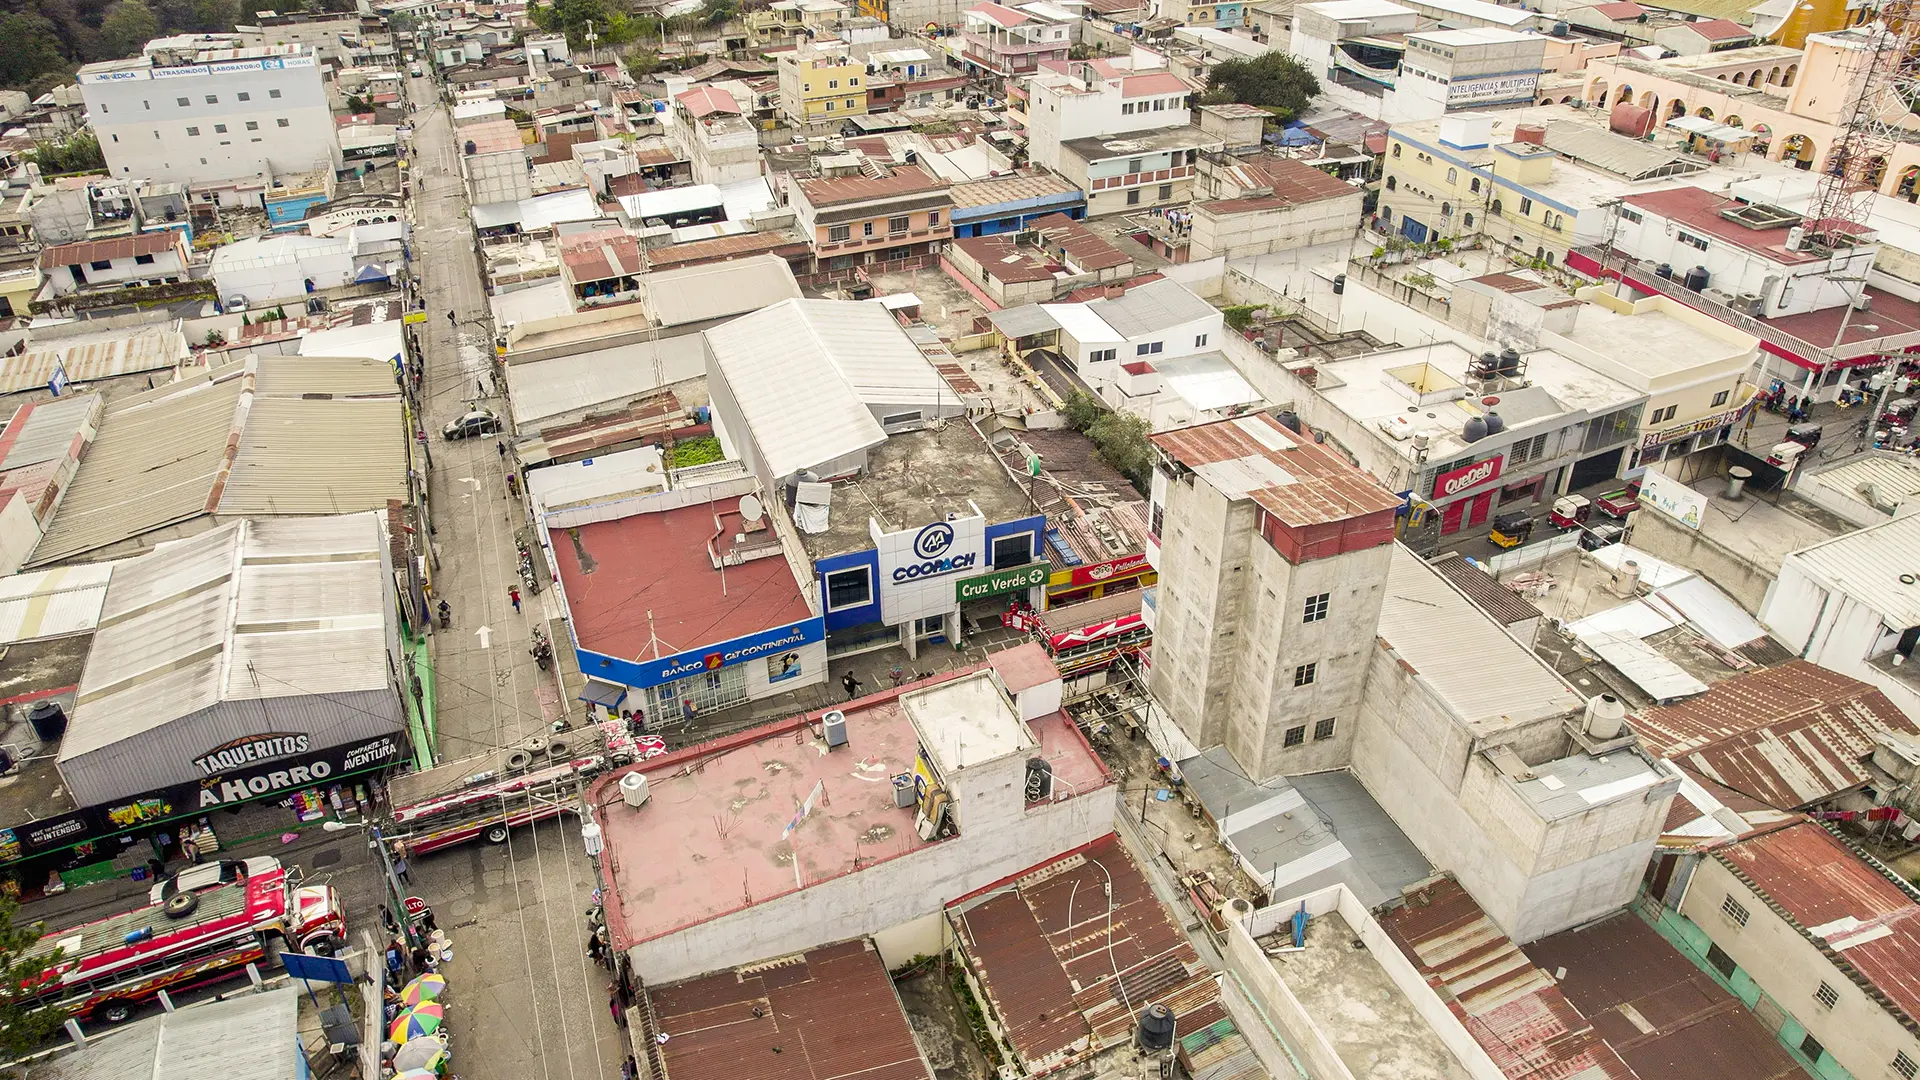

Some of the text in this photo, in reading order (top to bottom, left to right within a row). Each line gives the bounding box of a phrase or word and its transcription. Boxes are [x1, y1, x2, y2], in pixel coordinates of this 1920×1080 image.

[212, 63, 261, 73] LABORATORIO
[287, 59, 311, 67] HORAS
[154, 67, 208, 77] ULTRASONIDOS
[1449, 81, 1498, 94] INTELIGENCIAS
[893, 552, 976, 581] COOPACH
[962, 574, 1026, 597] Cruz Verde
[662, 661, 704, 678] BANCO
[743, 633, 806, 657] CONTINENTAL
[381, 737, 390, 745] TU
[195, 734, 309, 776] TAQUERITOS
[344, 743, 397, 771] AVENTURA
[43, 822, 81, 841] INTENSOS
[408, 901, 424, 910] LTO
